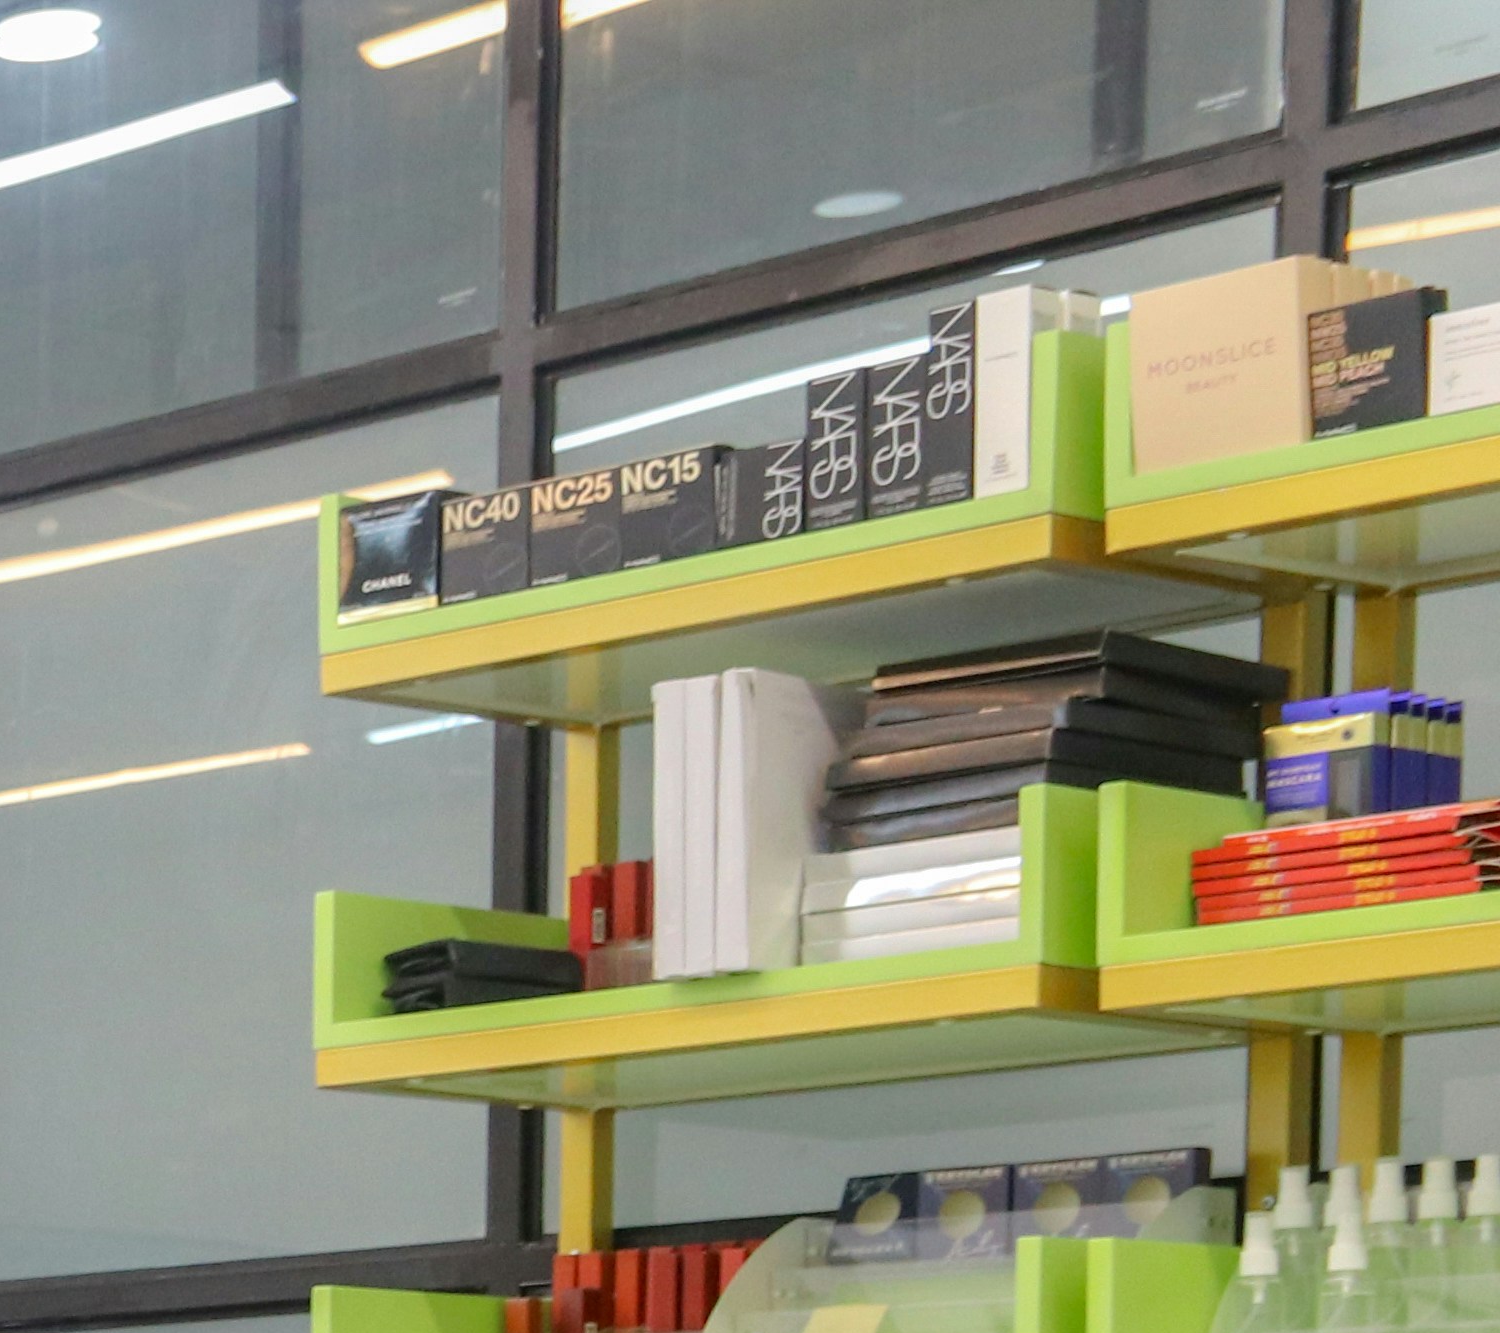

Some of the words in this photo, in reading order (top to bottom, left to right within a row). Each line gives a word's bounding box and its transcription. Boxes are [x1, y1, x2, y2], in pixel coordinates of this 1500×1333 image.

[925, 301, 973, 420] NARS
[1146, 337, 1276, 378] MOONSLICE
[1338, 344, 1396, 370] YELLOW
[1185, 372, 1238, 394] BEAUTY
[808, 370, 858, 500] NARS
[871, 356, 922, 487] NARS
[620, 452, 702, 493] NC15
[761, 438, 805, 539] NARS
[442, 494, 521, 534] NC40
[530, 473, 614, 515] NC25
[361, 572, 413, 594] CHANEL
